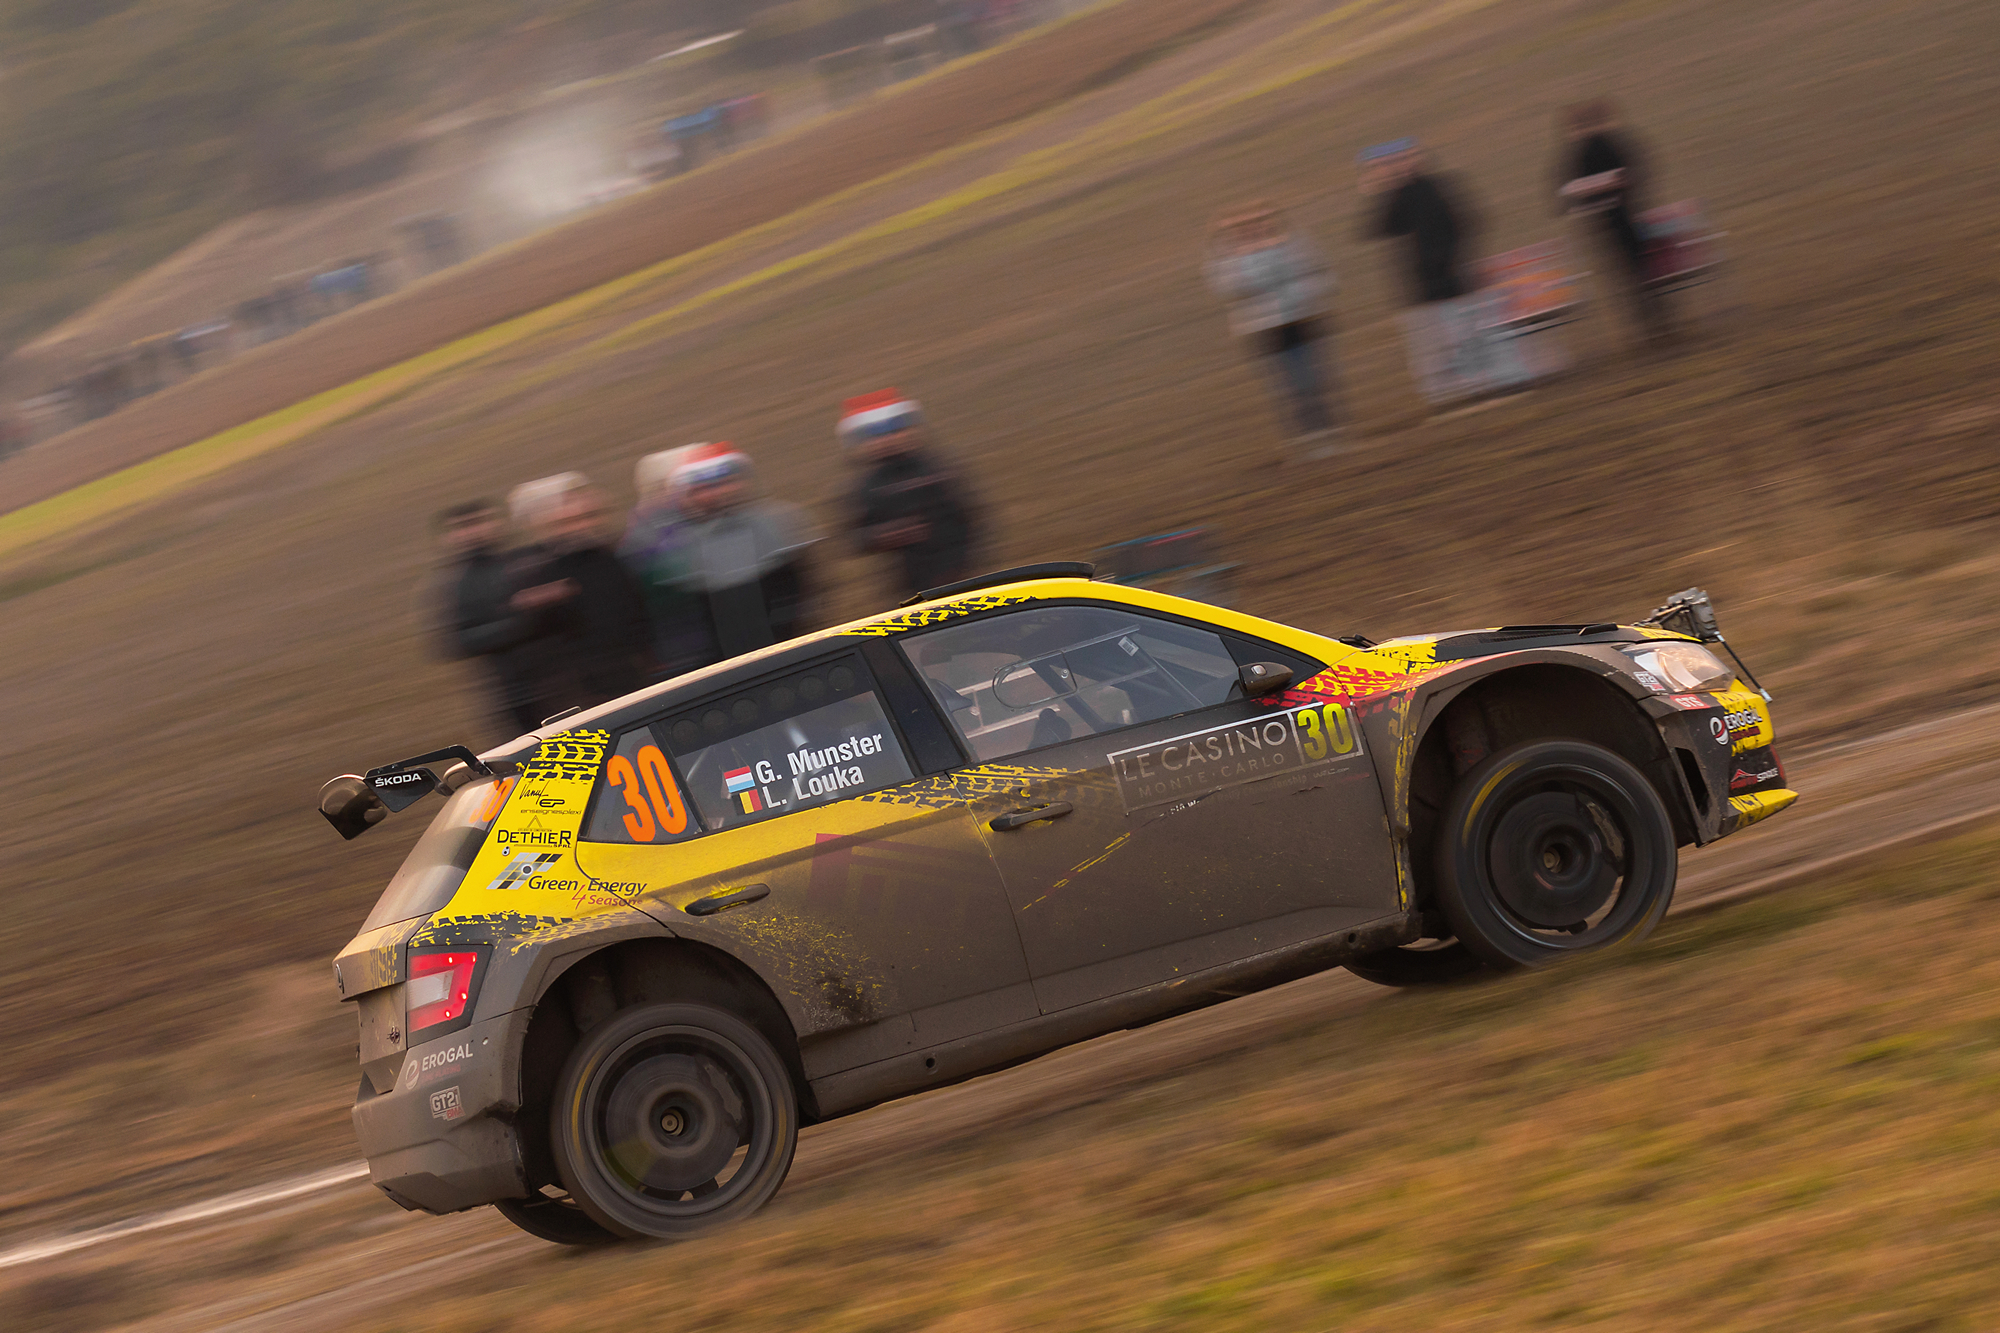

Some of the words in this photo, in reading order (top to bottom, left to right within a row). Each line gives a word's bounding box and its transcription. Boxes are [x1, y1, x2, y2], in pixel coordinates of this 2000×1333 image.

[1119, 752, 1156, 783] LE
[1160, 720, 1288, 772] CASINO
[1297, 702, 1355, 761] 30
[374, 773, 422, 788] ŠKODA
[755, 759, 783, 785] G.
[786, 732, 883, 776] Munster
[1138, 770, 1209, 798] MONTE
[1220, 753, 1285, 779] CARLO
[468, 777, 515, 823] 30
[607, 744, 688, 842] 30
[761, 785, 788, 809] L.
[792, 765, 865, 801] Louka
[497, 829, 572, 845] DETHIER
[528, 875, 579, 891] Green
[587, 877, 648, 897] Energy
[571, 884, 587, 911] 4
[422, 1043, 474, 1072] EROGAL
